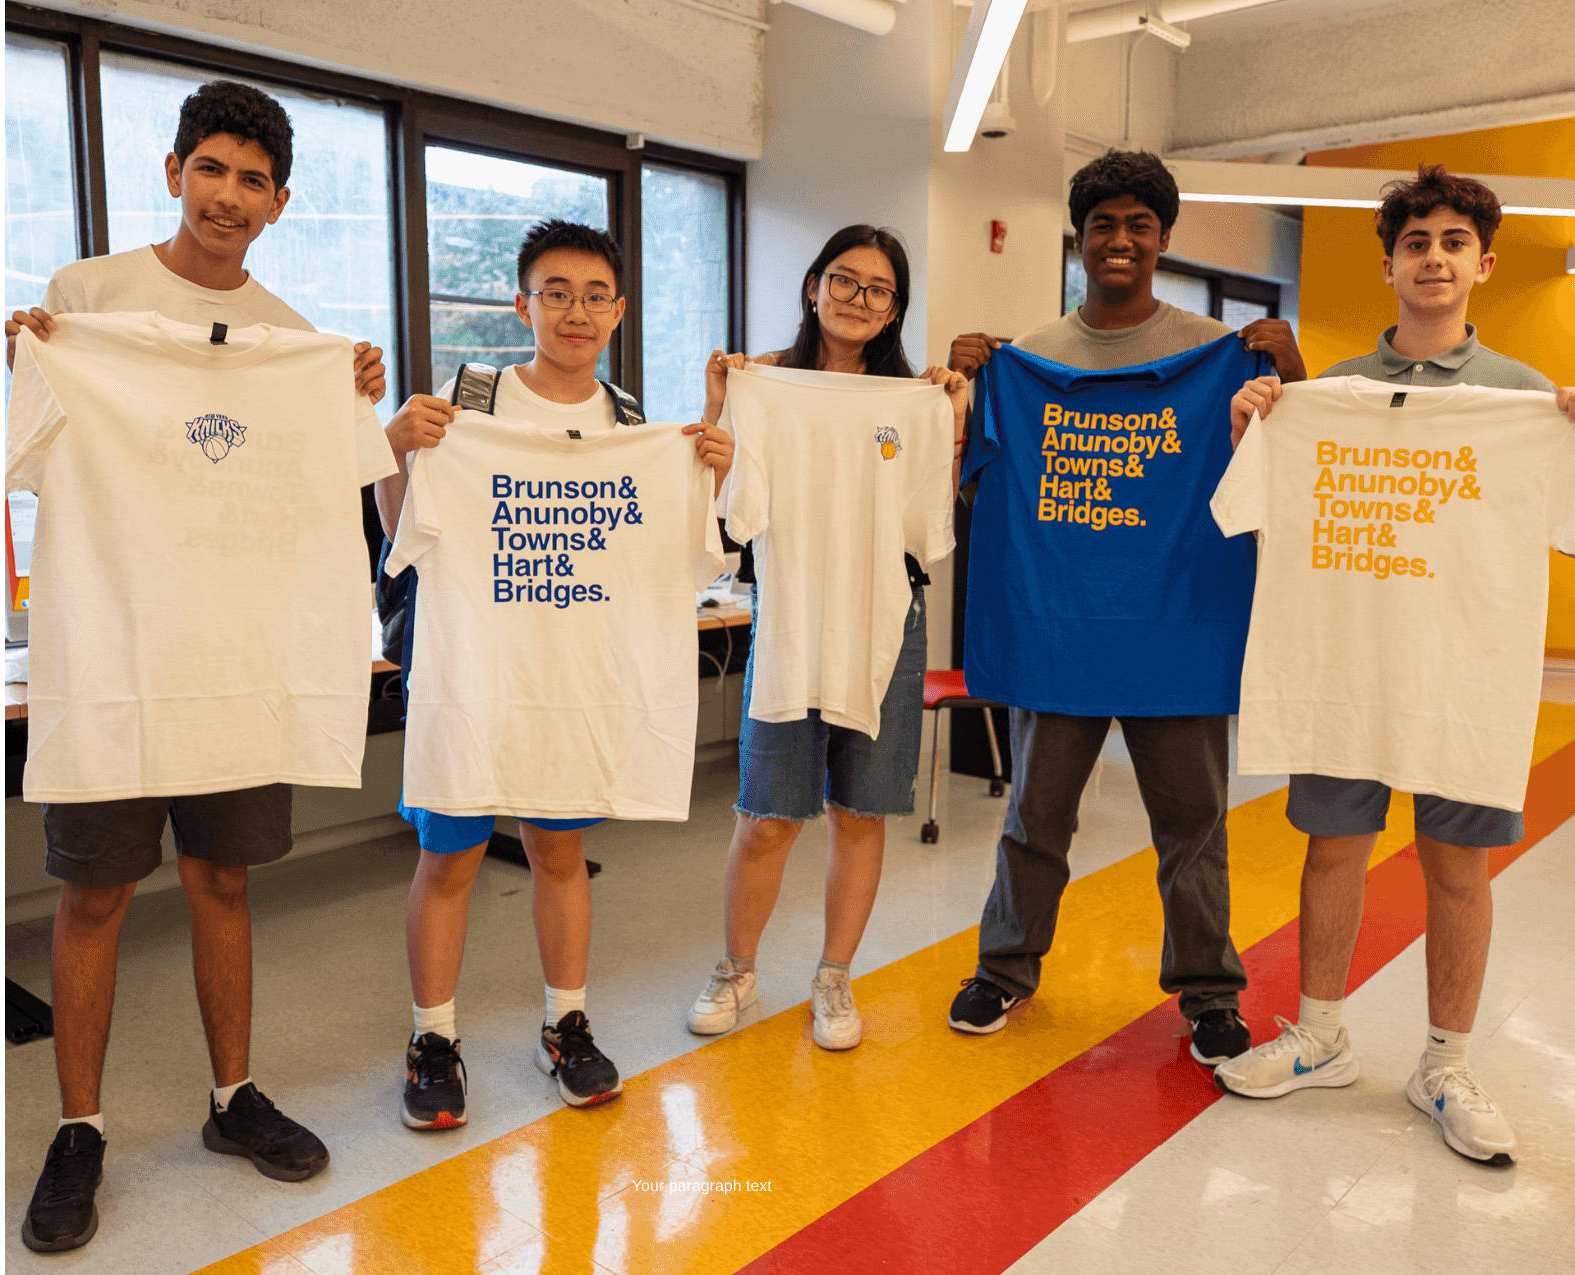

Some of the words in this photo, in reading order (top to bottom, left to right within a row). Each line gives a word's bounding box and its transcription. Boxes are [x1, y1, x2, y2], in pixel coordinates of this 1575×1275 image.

[185, 416, 246, 447] KNICKS
[1043, 403, 1177, 431] Brunson&
[1041, 427, 1182, 459] Anunoby&
[1316, 441, 1478, 473] Brunson&
[1041, 451, 1144, 478] Towns&
[492, 475, 638, 499] Brunson&
[1039, 474, 1112, 501] Hart&
[1314, 467, 1481, 504] Anunoby&
[491, 501, 644, 531] Anunoby&
[1038, 498, 1146, 531] Bridges.
[1313, 493, 1436, 524] Towns&
[491, 527, 607, 551] Towns&
[1312, 519, 1397, 548] Hart&
[493, 553, 574, 577] Hart&
[1311, 545, 1435, 580] Bridges.
[494, 578, 610, 609] Bridges.
